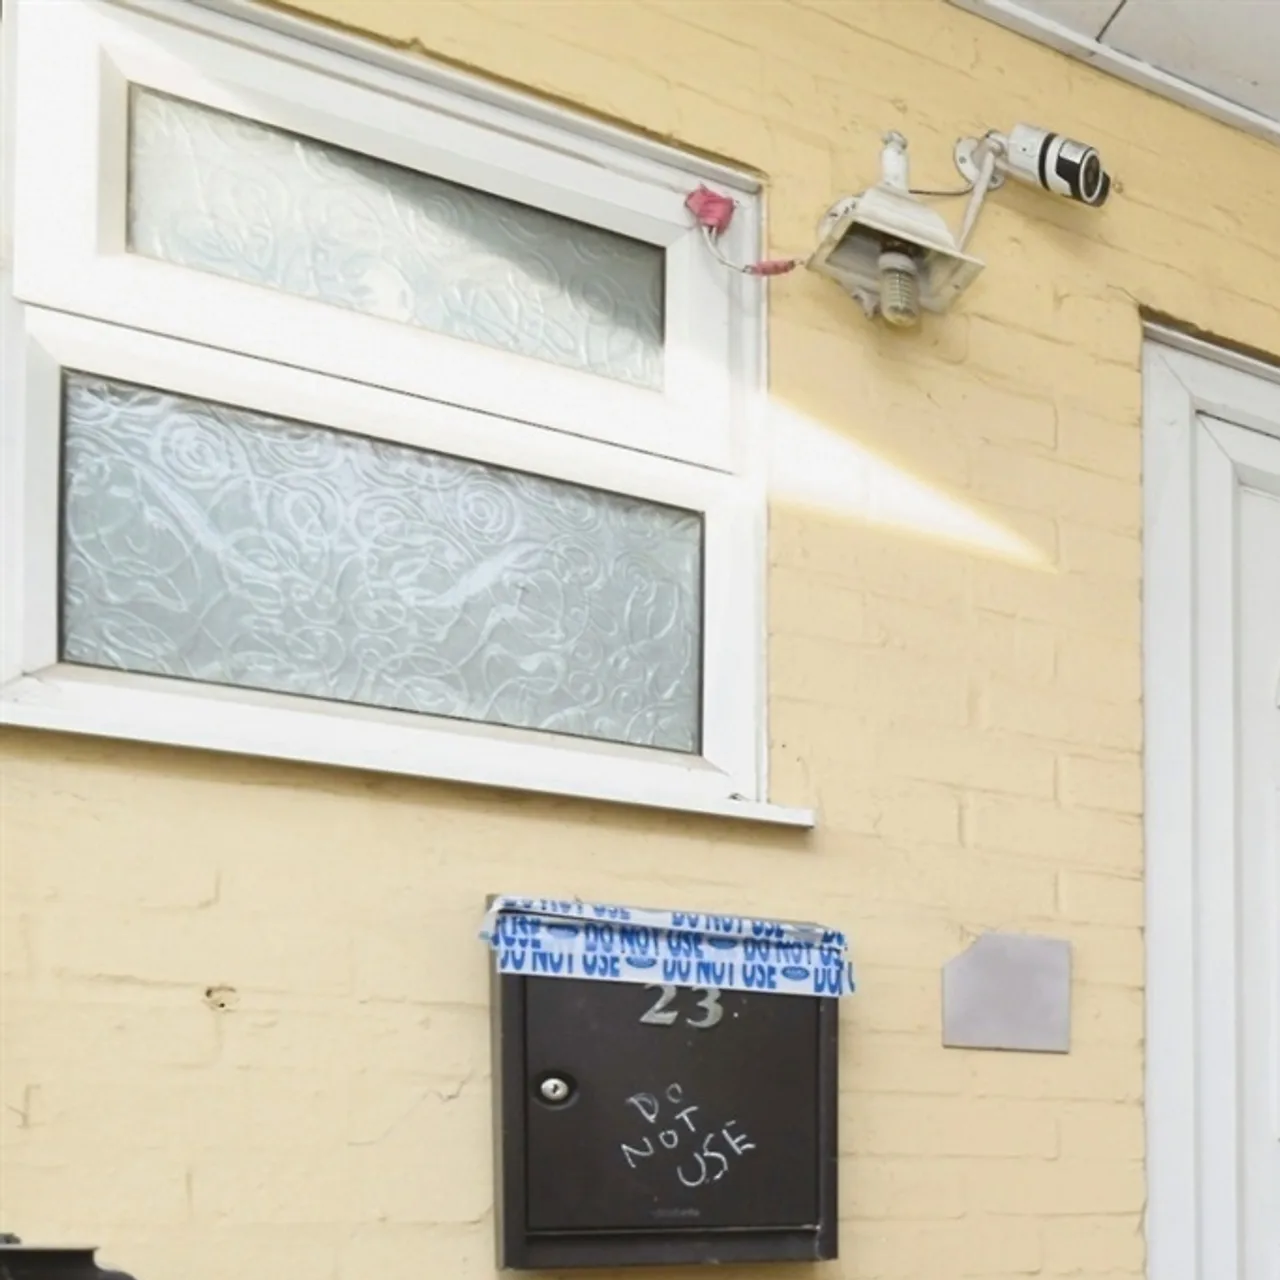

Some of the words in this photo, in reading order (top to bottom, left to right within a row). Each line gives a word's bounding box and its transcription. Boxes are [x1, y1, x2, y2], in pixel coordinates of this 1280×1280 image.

[585, 922, 614, 952] DO
[620, 926, 659, 956] NOT
[667, 929, 704, 958] USE
[743, 937, 770, 962] DO
[776, 940, 812, 965] NOT
[532, 951, 573, 974] NOT
[582, 953, 620, 977] USE
[663, 959, 690, 981] DO
[696, 961, 733, 986] NOT
[743, 964, 776, 989] USE
[639, 983, 724, 1029] 23
[621, 1105, 699, 1168] NOT
[676, 1119, 757, 1187] USE
